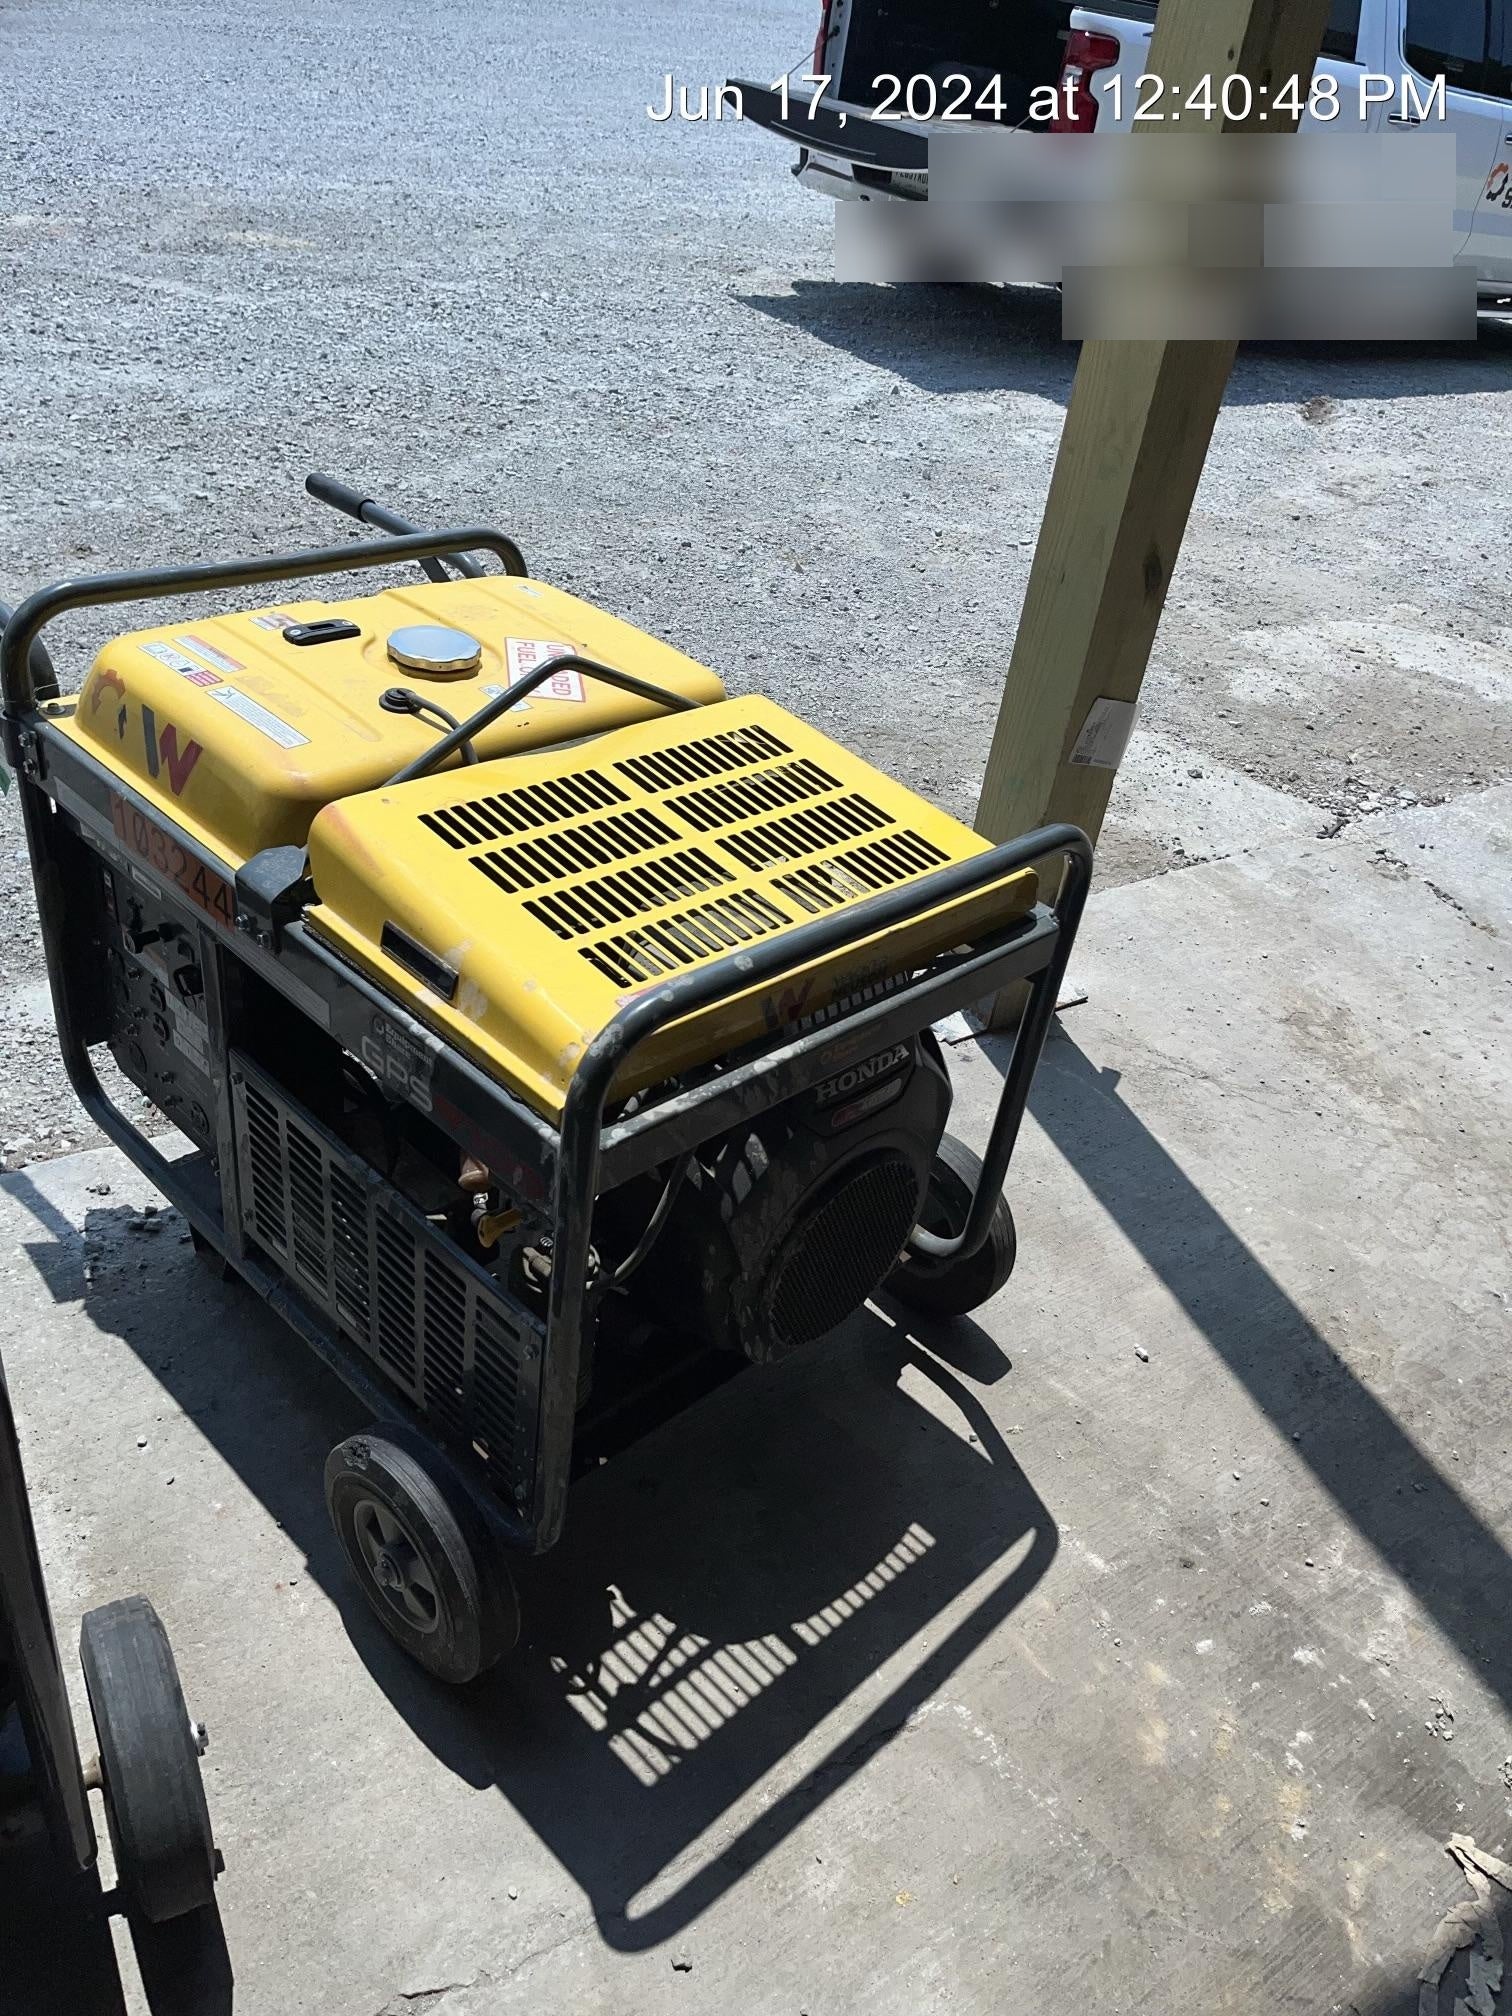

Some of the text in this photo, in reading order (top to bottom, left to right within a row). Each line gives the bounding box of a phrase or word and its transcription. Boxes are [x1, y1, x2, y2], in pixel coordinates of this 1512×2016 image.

[515, 641, 537, 663] FUEL
[546, 644, 572, 696] UNDED
[814, 1044, 910, 1103] HONDA
